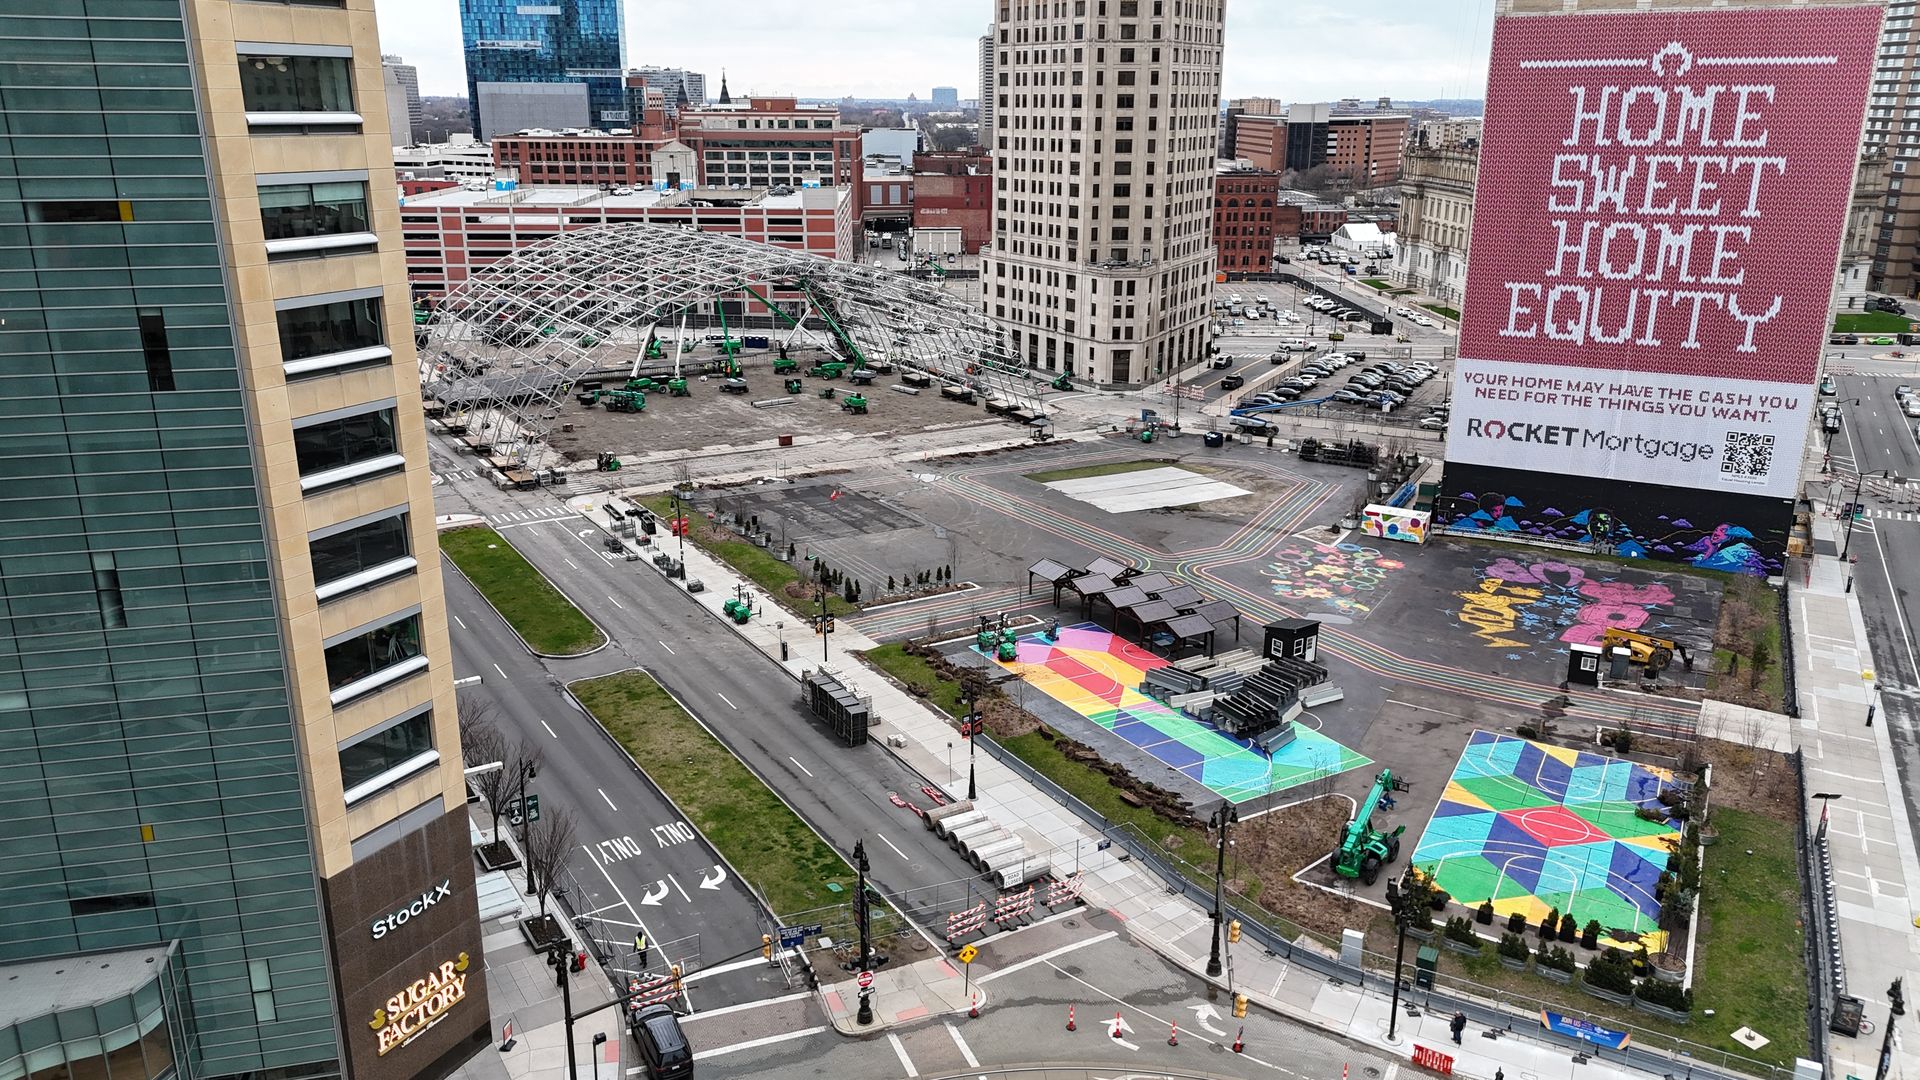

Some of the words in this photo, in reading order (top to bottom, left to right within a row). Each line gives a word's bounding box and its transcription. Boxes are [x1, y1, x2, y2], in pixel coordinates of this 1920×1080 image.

[1562, 84, 1775, 148] HOME
[1548, 153, 1786, 218] SWEET
[1545, 219, 1751, 285] HOME
[1499, 281, 1783, 353] EQUITY
[1464, 372, 1508, 386] YOUR
[1512, 375, 1562, 390] HOME
[1567, 380, 1604, 394] MAY
[1609, 383, 1653, 398] HAVE
[1658, 387, 1693, 401] THE
[1699, 391, 1752, 407] CASH
[1759, 395, 1798, 410] YOU
[1475, 387, 1519, 402] NEED
[1524, 391, 1558, 405] FOR
[1561, 393, 1592, 408] THE
[1598, 397, 1665, 415] THINGS
[1669, 403, 1706, 418] YOU
[1712, 406, 1772, 423] WANT.
[1467, 418, 1579, 447] ROCKET
[1583, 428, 1714, 462] Mortgage
[596, 836, 641, 864] ONLY
[650, 821, 695, 848] ONLY
[372, 879, 450, 939] StockX
[376, 974, 467, 1051] FACTORY
[385, 960, 457, 1021] SUGAR
